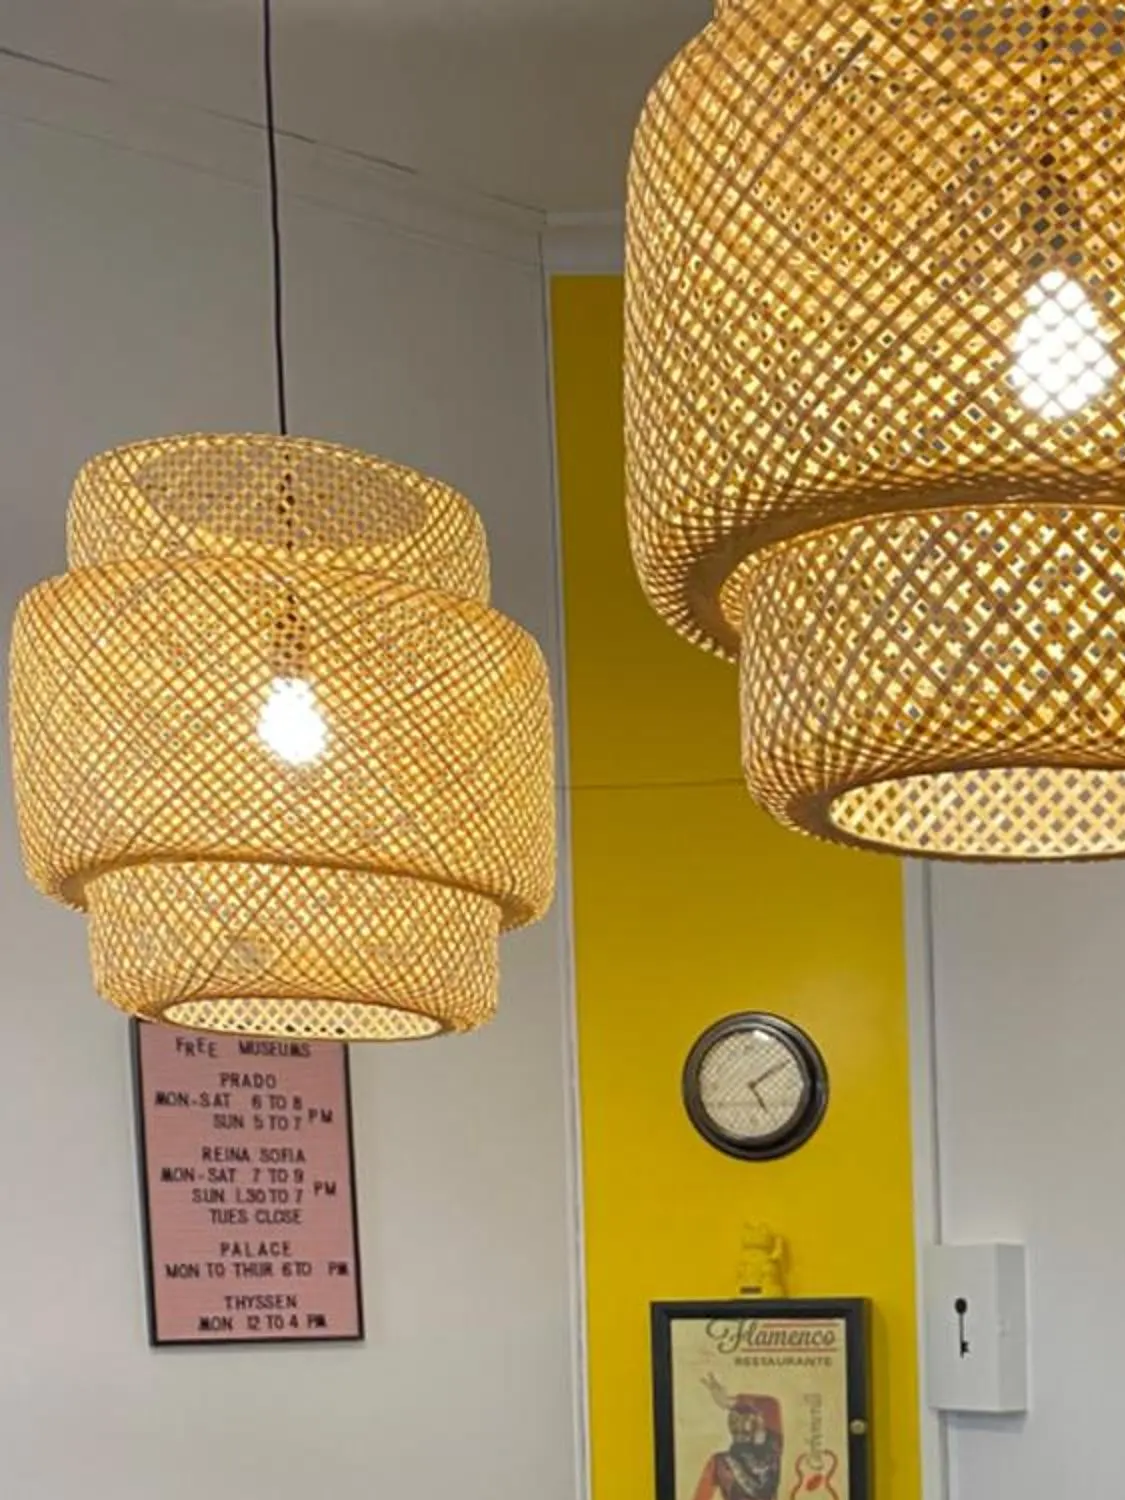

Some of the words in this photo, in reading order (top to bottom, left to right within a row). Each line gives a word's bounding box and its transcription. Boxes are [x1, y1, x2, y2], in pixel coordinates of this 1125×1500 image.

[176, 1037, 218, 1058] FREE
[219, 1072, 277, 1089] PRADO
[252, 1094, 263, 1110] 6
[268, 1095, 287, 1110] TO
[292, 1096, 303, 1110] 8
[213, 1113, 245, 1130] SUN
[253, 1114, 264, 1130] 5
[268, 1115, 288, 1130] TO
[293, 1116, 303, 1131] 7
[201, 1146, 250, 1163] REINA
[259, 1148, 306, 1164] SOFIA
[252, 1168, 261, 1183] 7
[267, 1168, 288, 1183] TO
[293, 1169, 304, 1184] 9
[192, 1187, 225, 1204] SUN
[268, 1189, 289, 1204] TO
[294, 1189, 303, 1204] 7
[209, 1208, 249, 1225] TUES
[255, 1208, 303, 1225] CLOSE
[219, 1240, 292, 1257] PALACE
[205, 1263, 226, 1278] TO
[232, 1262, 273, 1278] THUR
[327, 1261, 350, 1276] PM
[223, 1294, 298, 1310] THYSSEN
[198, 1315, 233, 1331] MON
[246, 1315, 260, 1331] 12
[265, 1314, 284, 1330] TO
[289, 1314, 298, 1328] 4
[306, 1313, 328, 1329] PM
[705, 1318, 836, 1354] Flamenco
[734, 1356, 833, 1368] RESTAURANTE
